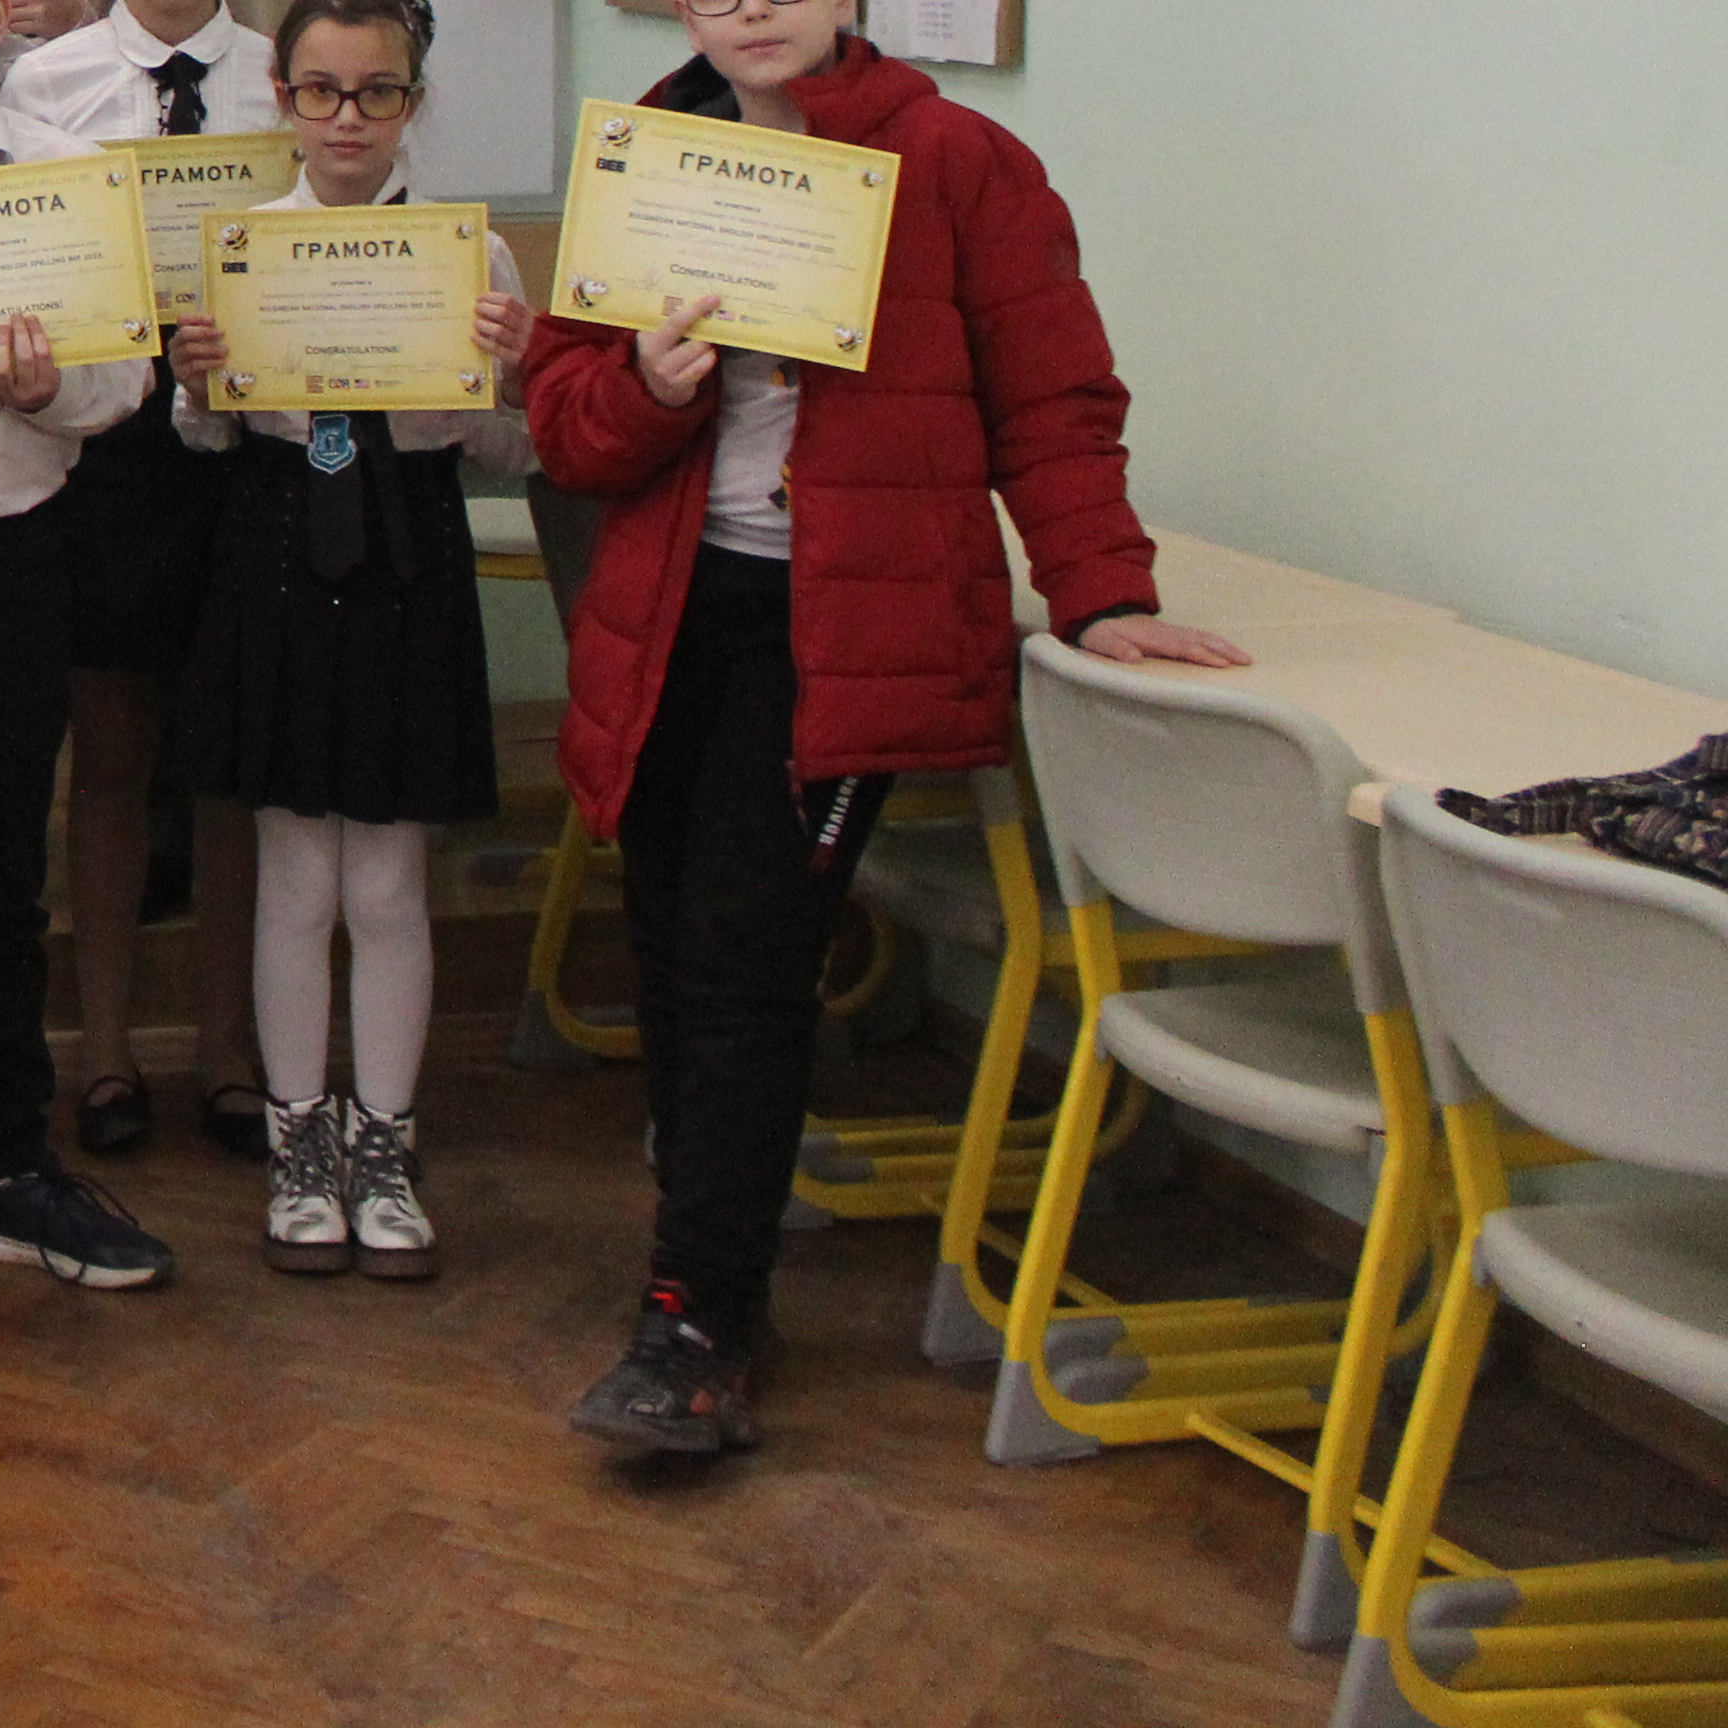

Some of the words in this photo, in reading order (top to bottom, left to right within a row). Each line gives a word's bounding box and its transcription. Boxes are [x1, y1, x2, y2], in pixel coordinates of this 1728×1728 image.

[141, 163, 253, 185] ГРАМОТА
[679, 151, 812, 193] ГРАМОТА
[292, 239, 414, 260] ГРАМОТА
